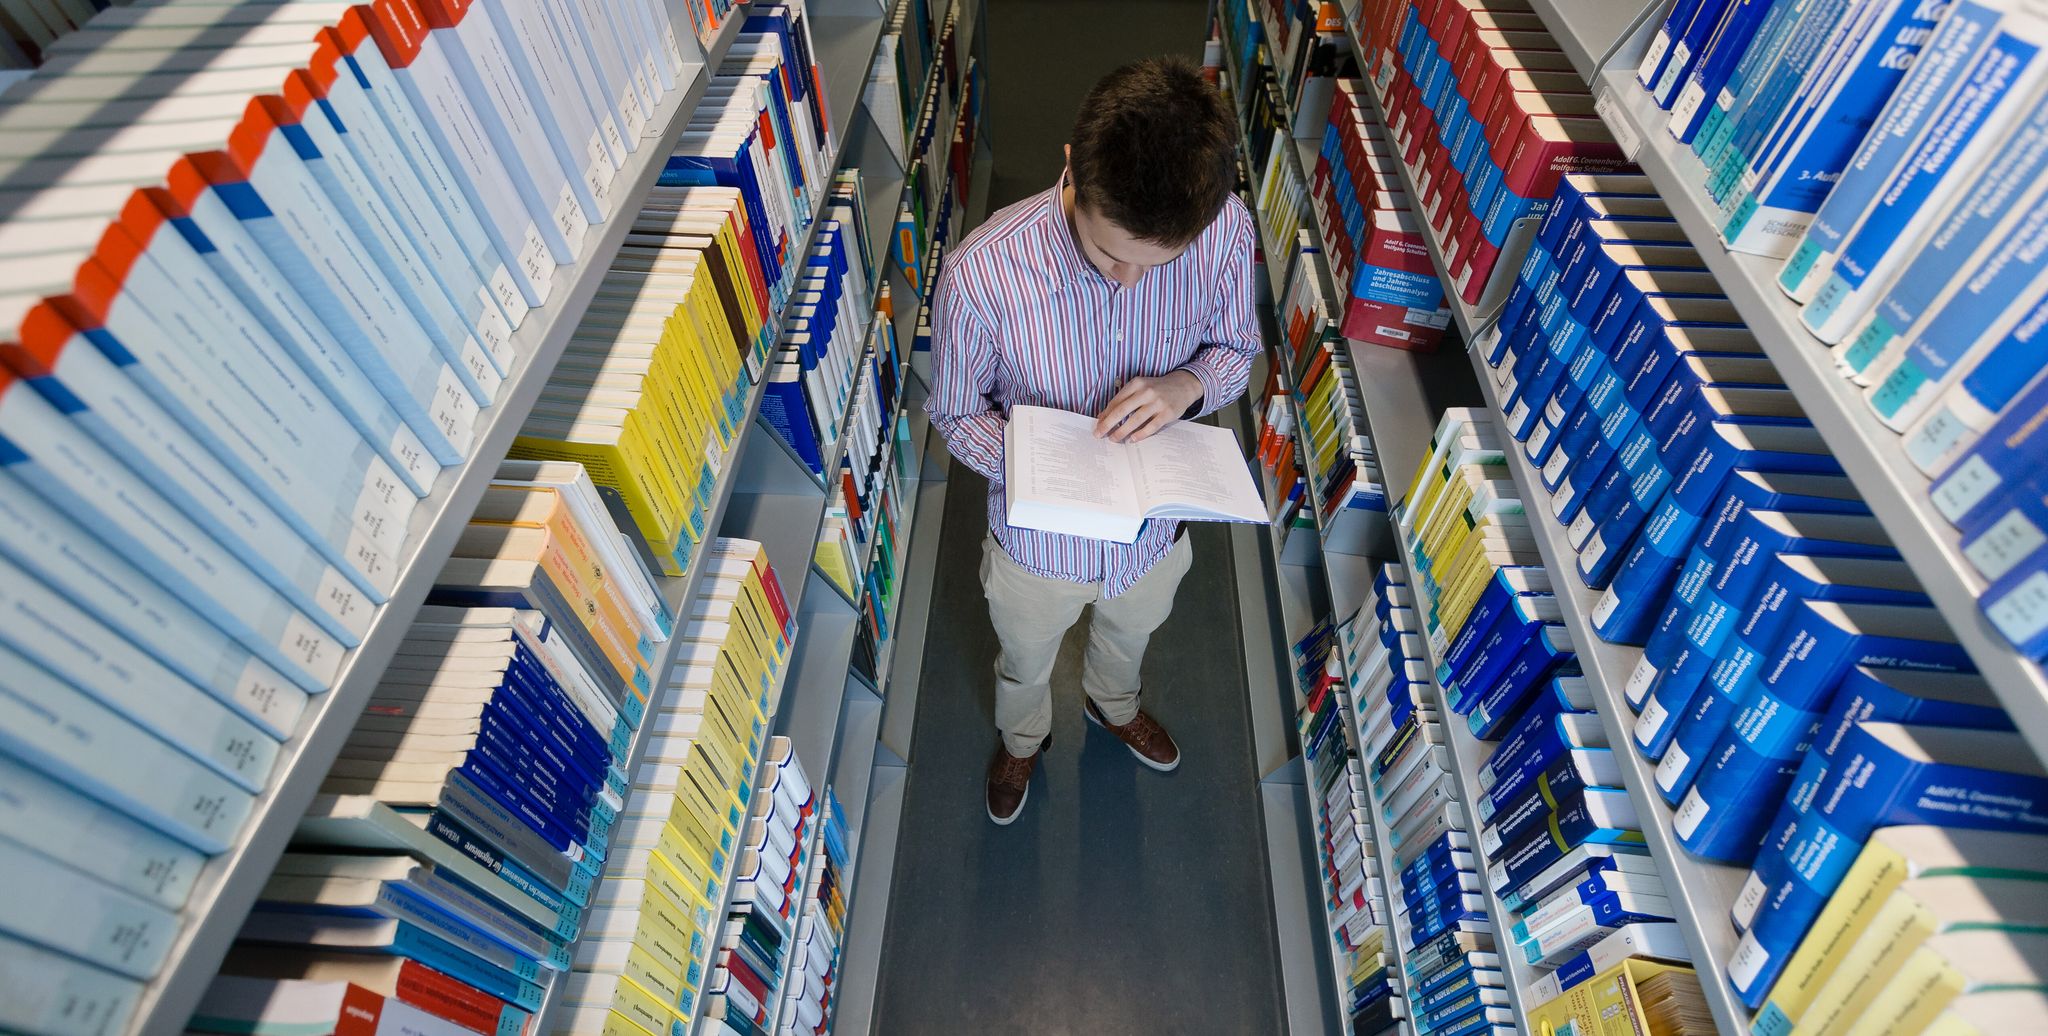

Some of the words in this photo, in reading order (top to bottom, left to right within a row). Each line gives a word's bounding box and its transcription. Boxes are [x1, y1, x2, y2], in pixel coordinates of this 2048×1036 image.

[1894, 25, 1934, 45] un
[1878, 45, 1917, 70] Ko
[1892, 22, 1981, 138] Kostenanalyse
[1855, 51, 1944, 171] Kostenrechnung
[1922, 55, 2019, 174] Kostenanalyse
[1884, 85, 1979, 207] Kostenrechnung
[1812, 170, 1842, 183] Aufl
[1530, 202, 1549, 212] Jah
[1383, 244, 1406, 253] Wolfgang
[1406, 248, 1427, 256] Schultze
[1372, 275, 1386, 283] und
[1386, 277, 1413, 287] Jahres-
[1374, 268, 1430, 284] Jahresabschluss
[1370, 281, 1429, 297] abschlussanalyse
[1704, 494, 1737, 548] Coenenberg/Fischer
[1728, 499, 1745, 523] Günther
[1653, 508, 1680, 545] Kostenanalyse
[1696, 559, 1706, 572] und
[1717, 536, 1751, 590] Coenenberg/Fischer
[1741, 541, 1760, 566] Günther
[1686, 562, 1714, 605] Kostenanalyse
[1743, 581, 1780, 636] Coenenberg/Fischer
[1768, 587, 1788, 612] Günther
[1692, 614, 1712, 642] rechnung
[1708, 600, 1718, 615] und
[1697, 605, 1728, 647] Kostenanalyse
[1676, 650, 1690, 669] Auflage
[1767, 629, 1808, 684] Coenenberg/Fischer
[1796, 636, 1818, 661] Günther
[1716, 659, 1739, 688] rechnung
[1734, 646, 1745, 661] und
[1722, 651, 1754, 694] Kostenanalyse
[1699, 695, 1714, 715] Auflage
[1740, 708, 1763, 736] rechnung
[1758, 695, 1770, 710] und
[1745, 701, 1780, 744] Kostenanalyse
[1721, 743, 1737, 764] Auflage
[1925, 784, 1957, 796] Adolf
[1917, 796, 1958, 813] Thomas
[437, 823, 460, 844] VIEBAHN
[464, 841, 492, 868] Ingenieure
[493, 861, 502, 873] für
[1802, 832, 1839, 881] Kostenanalyse
[501, 865, 529, 890] Basiswissen
